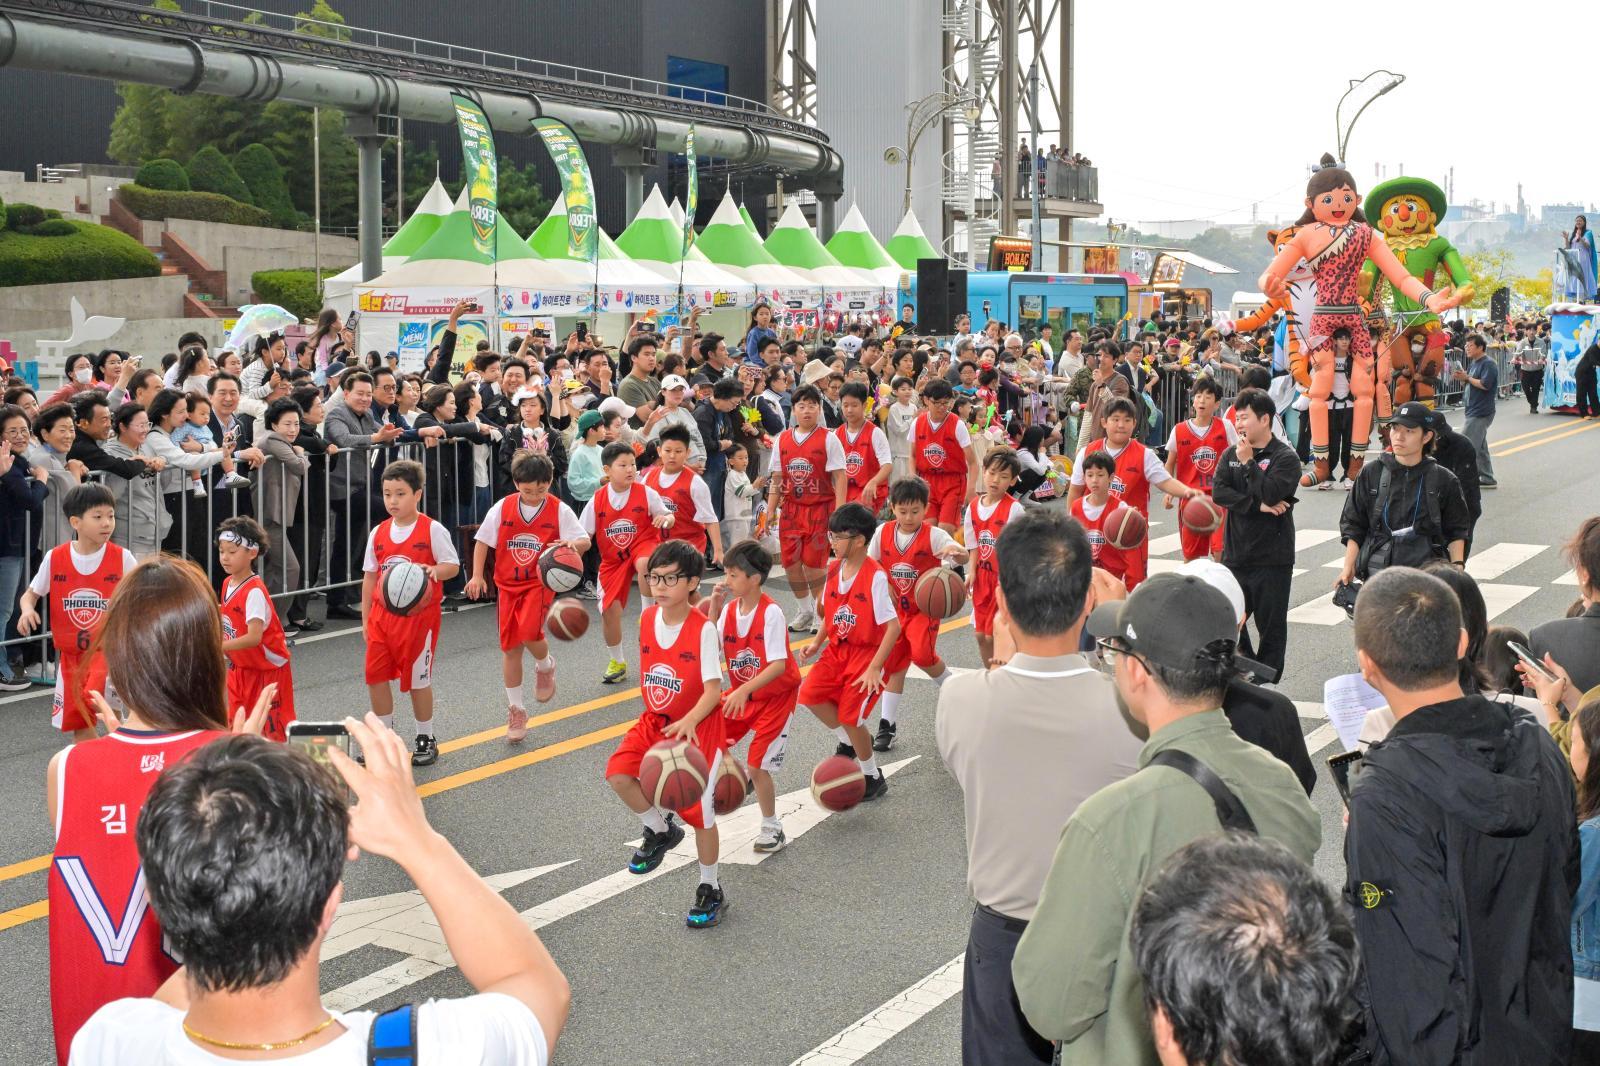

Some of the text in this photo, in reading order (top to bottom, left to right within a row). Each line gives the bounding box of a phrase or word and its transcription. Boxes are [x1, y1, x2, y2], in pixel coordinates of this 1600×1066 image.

[542, 295, 571, 306] 하이트진로
[402, 333, 425, 345] MENU
[508, 541, 541, 552] PHOEBUS
[64, 599, 109, 611] PHOEBUS
[77, 630, 90, 651] 6
[644, 673, 682, 692] PHOEBUS
